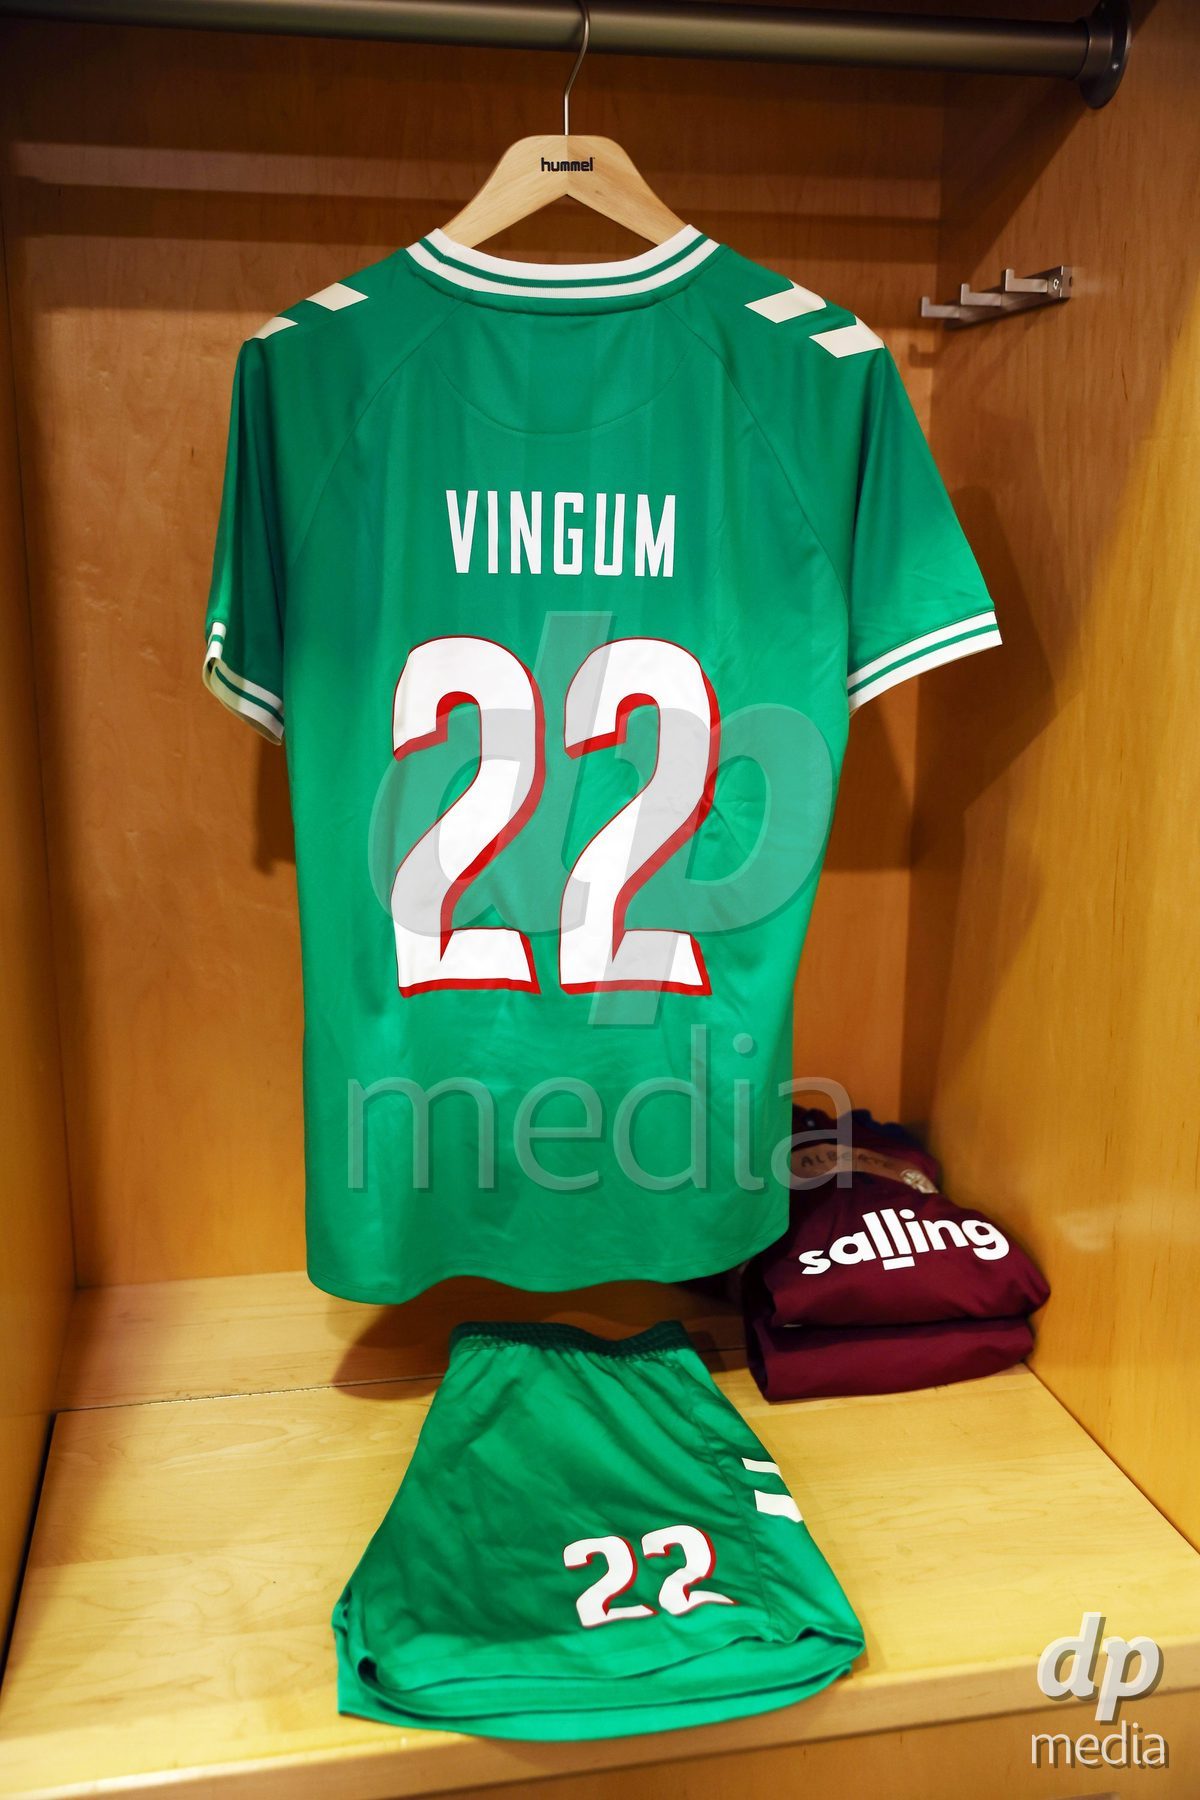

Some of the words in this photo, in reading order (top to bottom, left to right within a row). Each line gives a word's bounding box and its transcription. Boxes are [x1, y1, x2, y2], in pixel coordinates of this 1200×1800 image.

[541, 157, 594, 172] hummel
[445, 489, 676, 578] VINGUM
[391, 634, 721, 998] 22
[798, 1208, 1010, 1275] salling
[562, 1524, 739, 1630] 22
